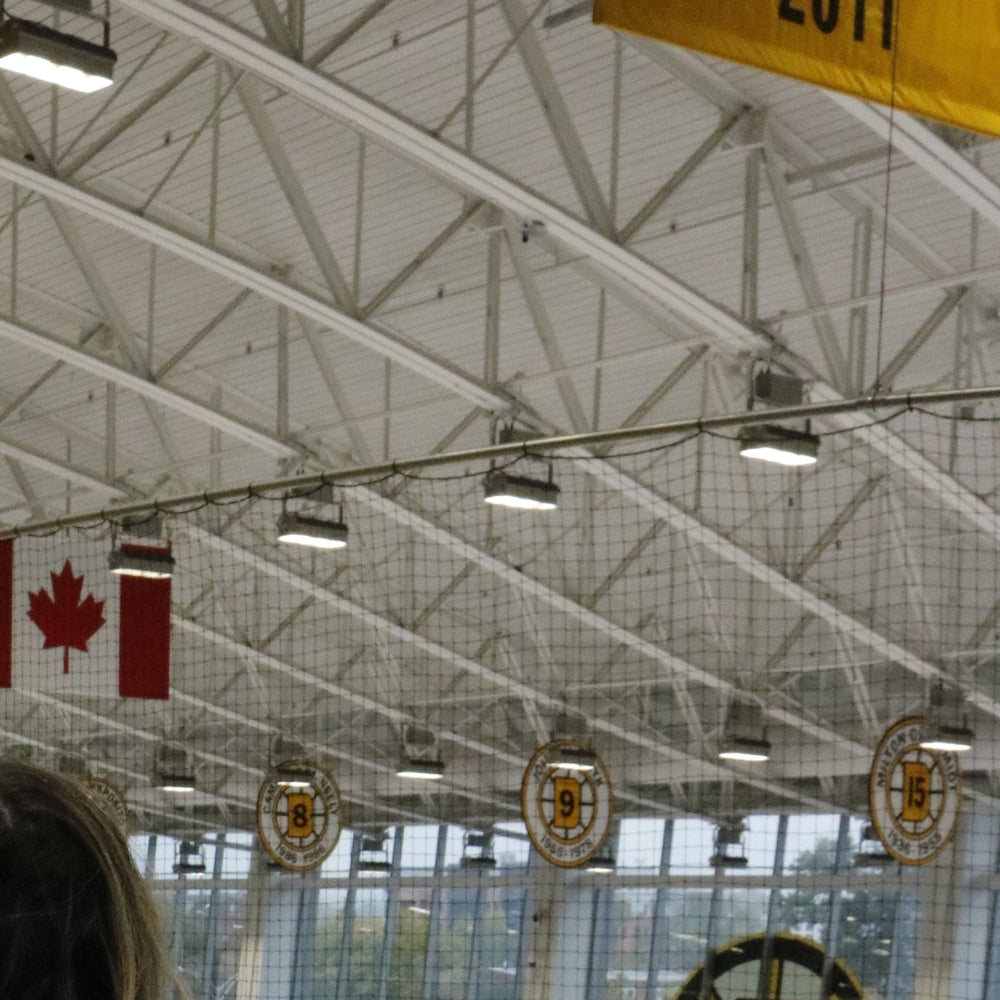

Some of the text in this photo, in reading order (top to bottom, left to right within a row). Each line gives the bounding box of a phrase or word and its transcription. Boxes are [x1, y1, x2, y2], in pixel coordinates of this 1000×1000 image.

[560, 790, 575, 817] 9
[908, 776, 926, 809] 15
[293, 804, 308, 828] 8
